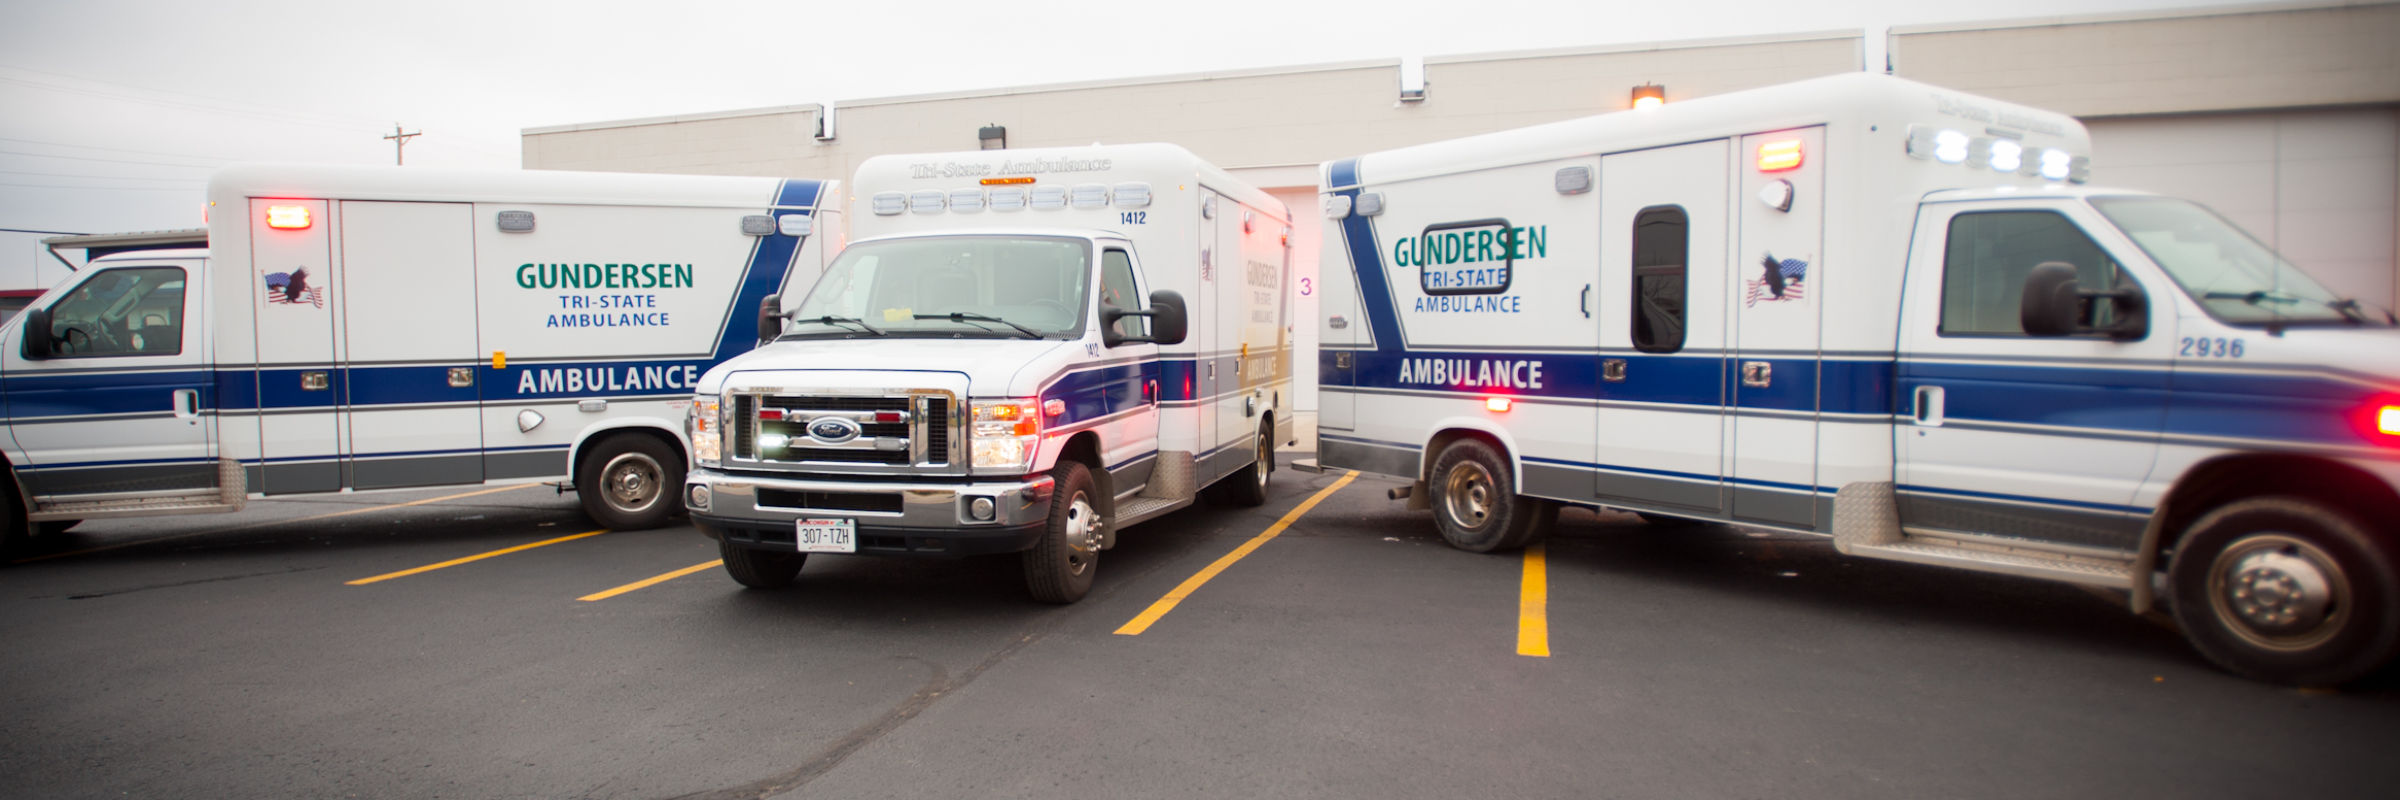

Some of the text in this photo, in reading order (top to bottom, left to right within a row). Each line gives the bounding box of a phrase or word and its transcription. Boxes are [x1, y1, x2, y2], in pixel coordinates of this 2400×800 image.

[910, 156, 1112, 179] Tri-State Ambulance
[1121, 211, 1146, 225] 1412
[1394, 225, 1547, 267] GUNDERSEN
[516, 263, 693, 289] GUNDERSEN
[1424, 268, 1507, 287] TRI-STATE
[1300, 277, 1312, 296] 3
[559, 295, 656, 309] TRI-STATE
[1415, 296, 1521, 313] AMBULANCE
[547, 313, 670, 328] AMBULANCE
[1085, 342, 1100, 358] 1412
[2179, 336, 2245, 359] 2936
[518, 365, 698, 394] AMBULANCE
[1399, 358, 1543, 389] AMBULANCE
[819, 424, 843, 436] Ford
[802, 528, 849, 544] 307-TZH
